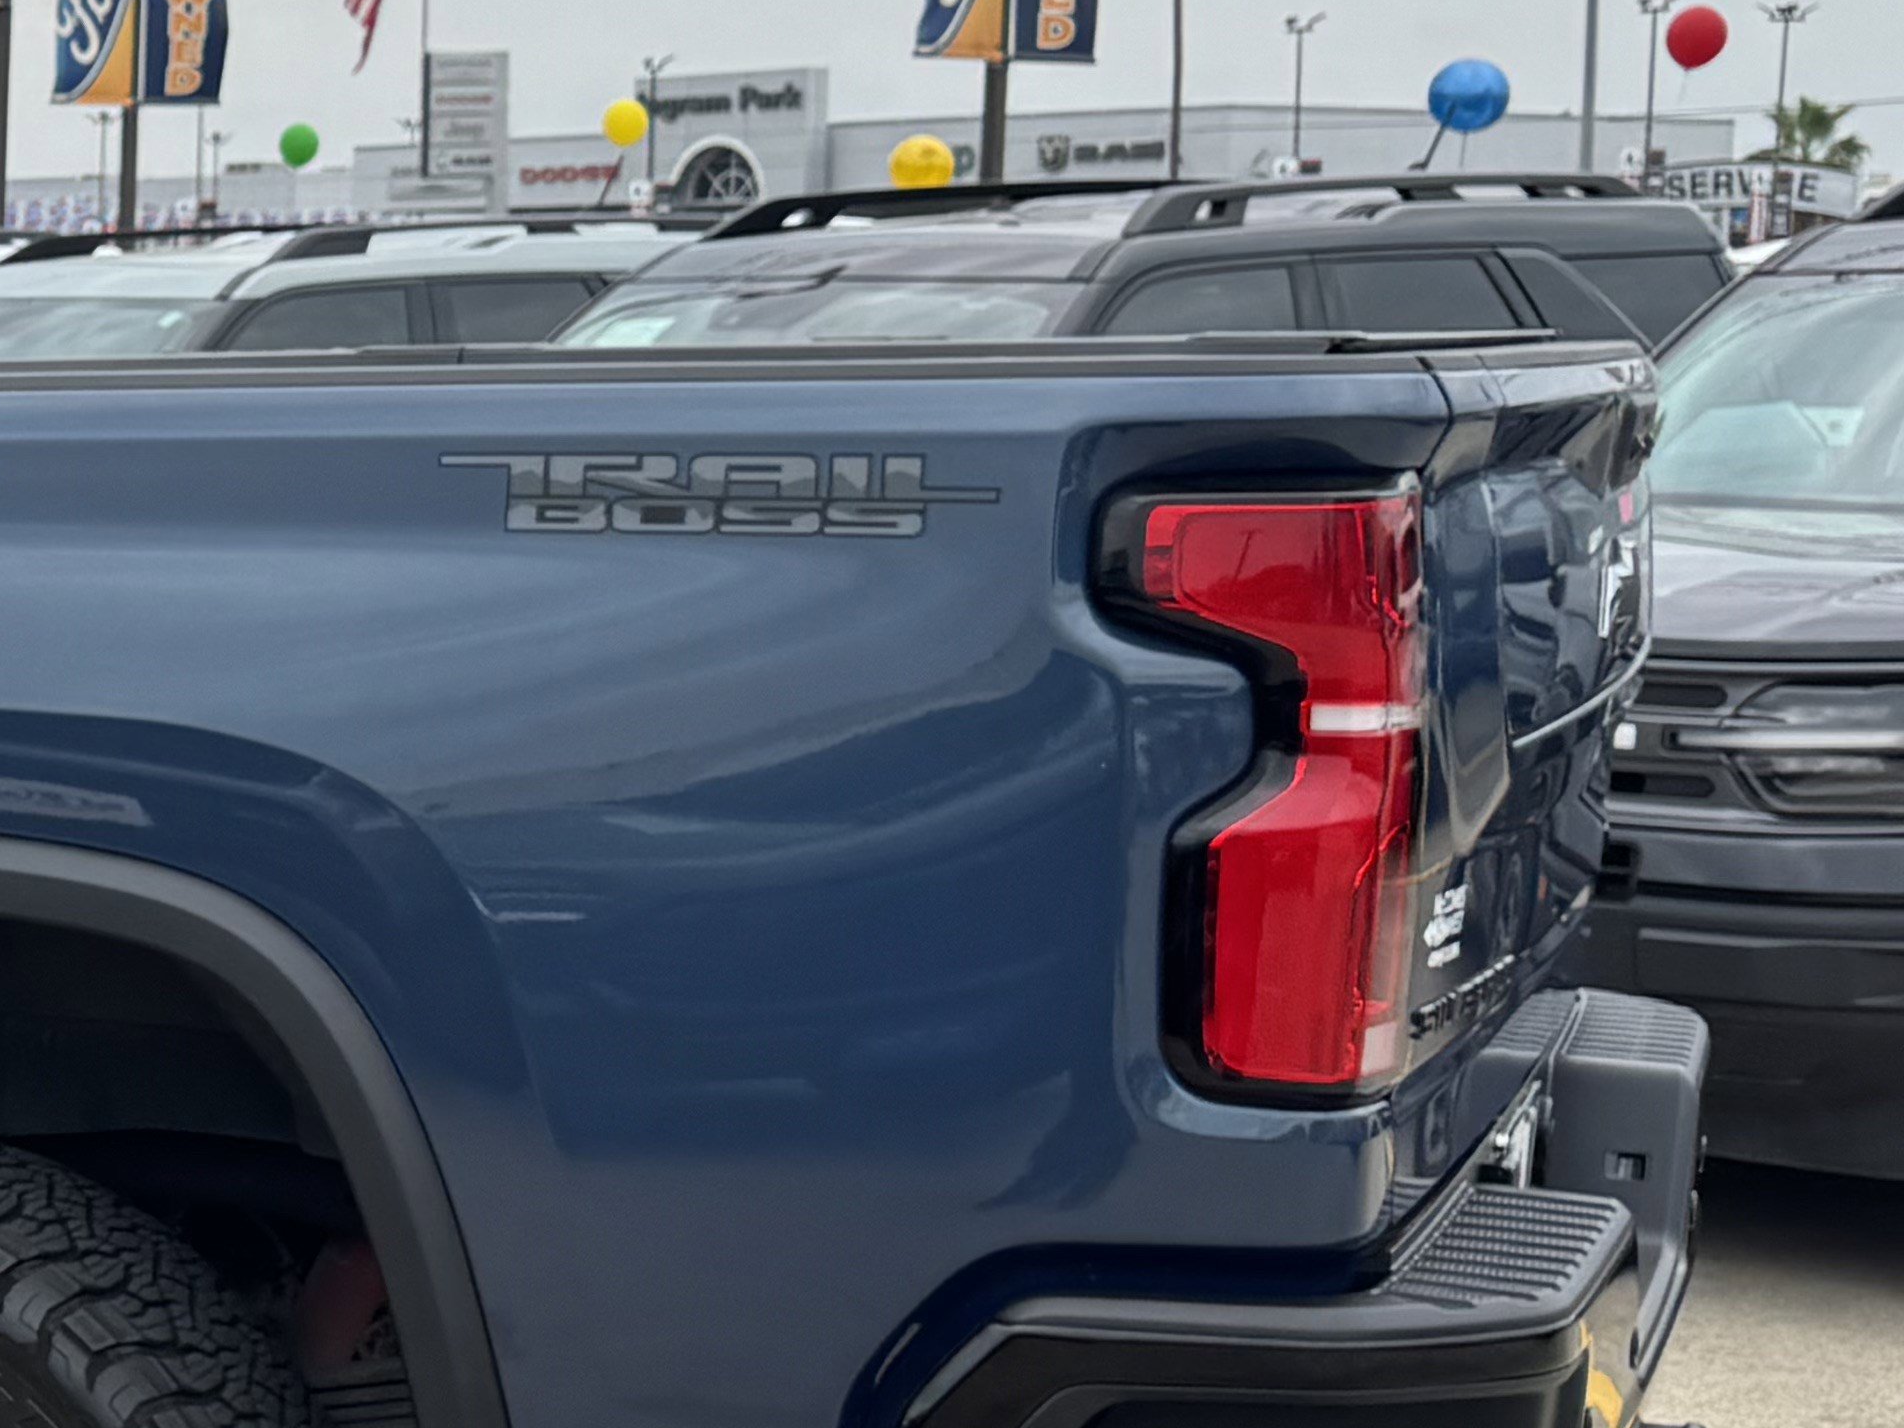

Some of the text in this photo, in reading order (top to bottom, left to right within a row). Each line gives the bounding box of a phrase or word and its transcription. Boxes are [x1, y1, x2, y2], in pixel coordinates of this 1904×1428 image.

[739, 83, 802, 113] Park
[519, 164, 620, 185] DODGE
[1665, 168, 1819, 203] SERVE
[438, 452, 1001, 504] TRAIL
[504, 497, 927, 539] BOSS
